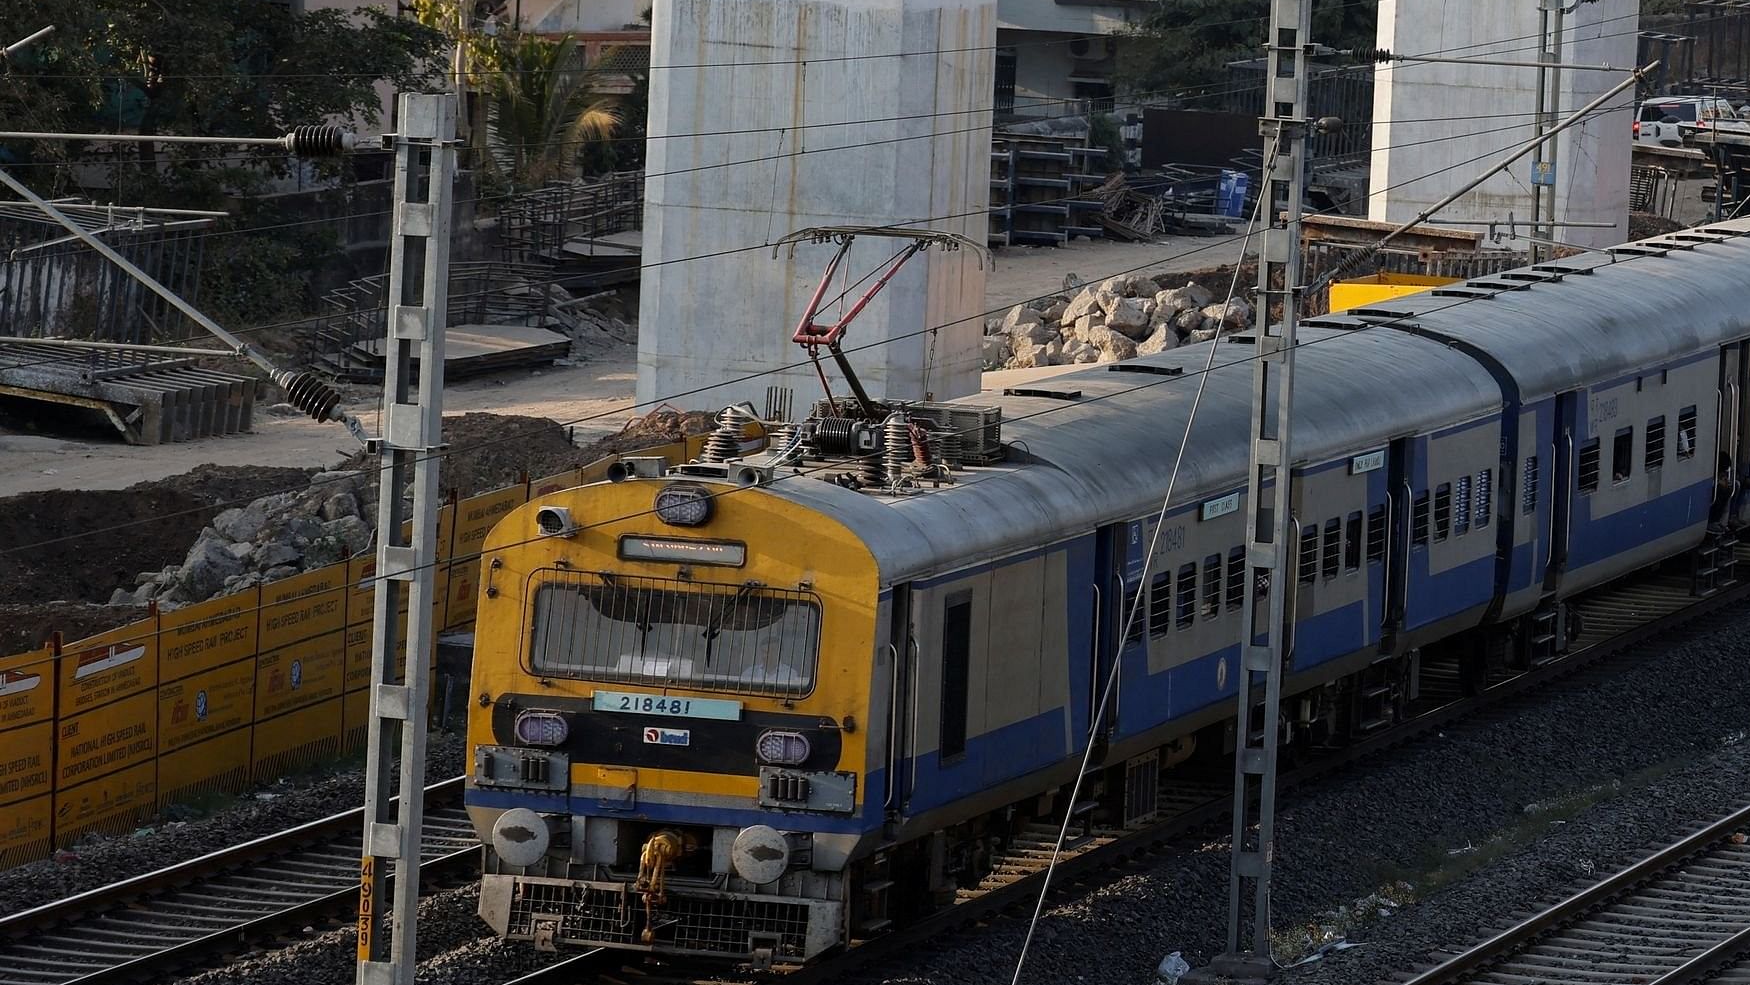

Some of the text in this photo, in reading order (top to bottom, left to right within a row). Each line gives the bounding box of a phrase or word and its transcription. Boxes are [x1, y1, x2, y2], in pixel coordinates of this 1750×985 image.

[266, 599, 338, 632] HIGH SPEED RAIL PROJECT
[167, 626, 249, 662] HIGH SPEED RAIL PROJECT
[620, 696, 691, 715] 218481
[61, 721, 79, 738] CLIENT
[70, 722, 147, 758] NATIONAL HIGH SPEED RAIL
[8, 757, 26, 774] SPEED
[26, 755, 41, 768] RAIL
[62, 758, 103, 780] CORPORATION
[102, 747, 127, 768] LIMITED
[361, 861, 373, 913] 490
[360, 917, 370, 946] 39
